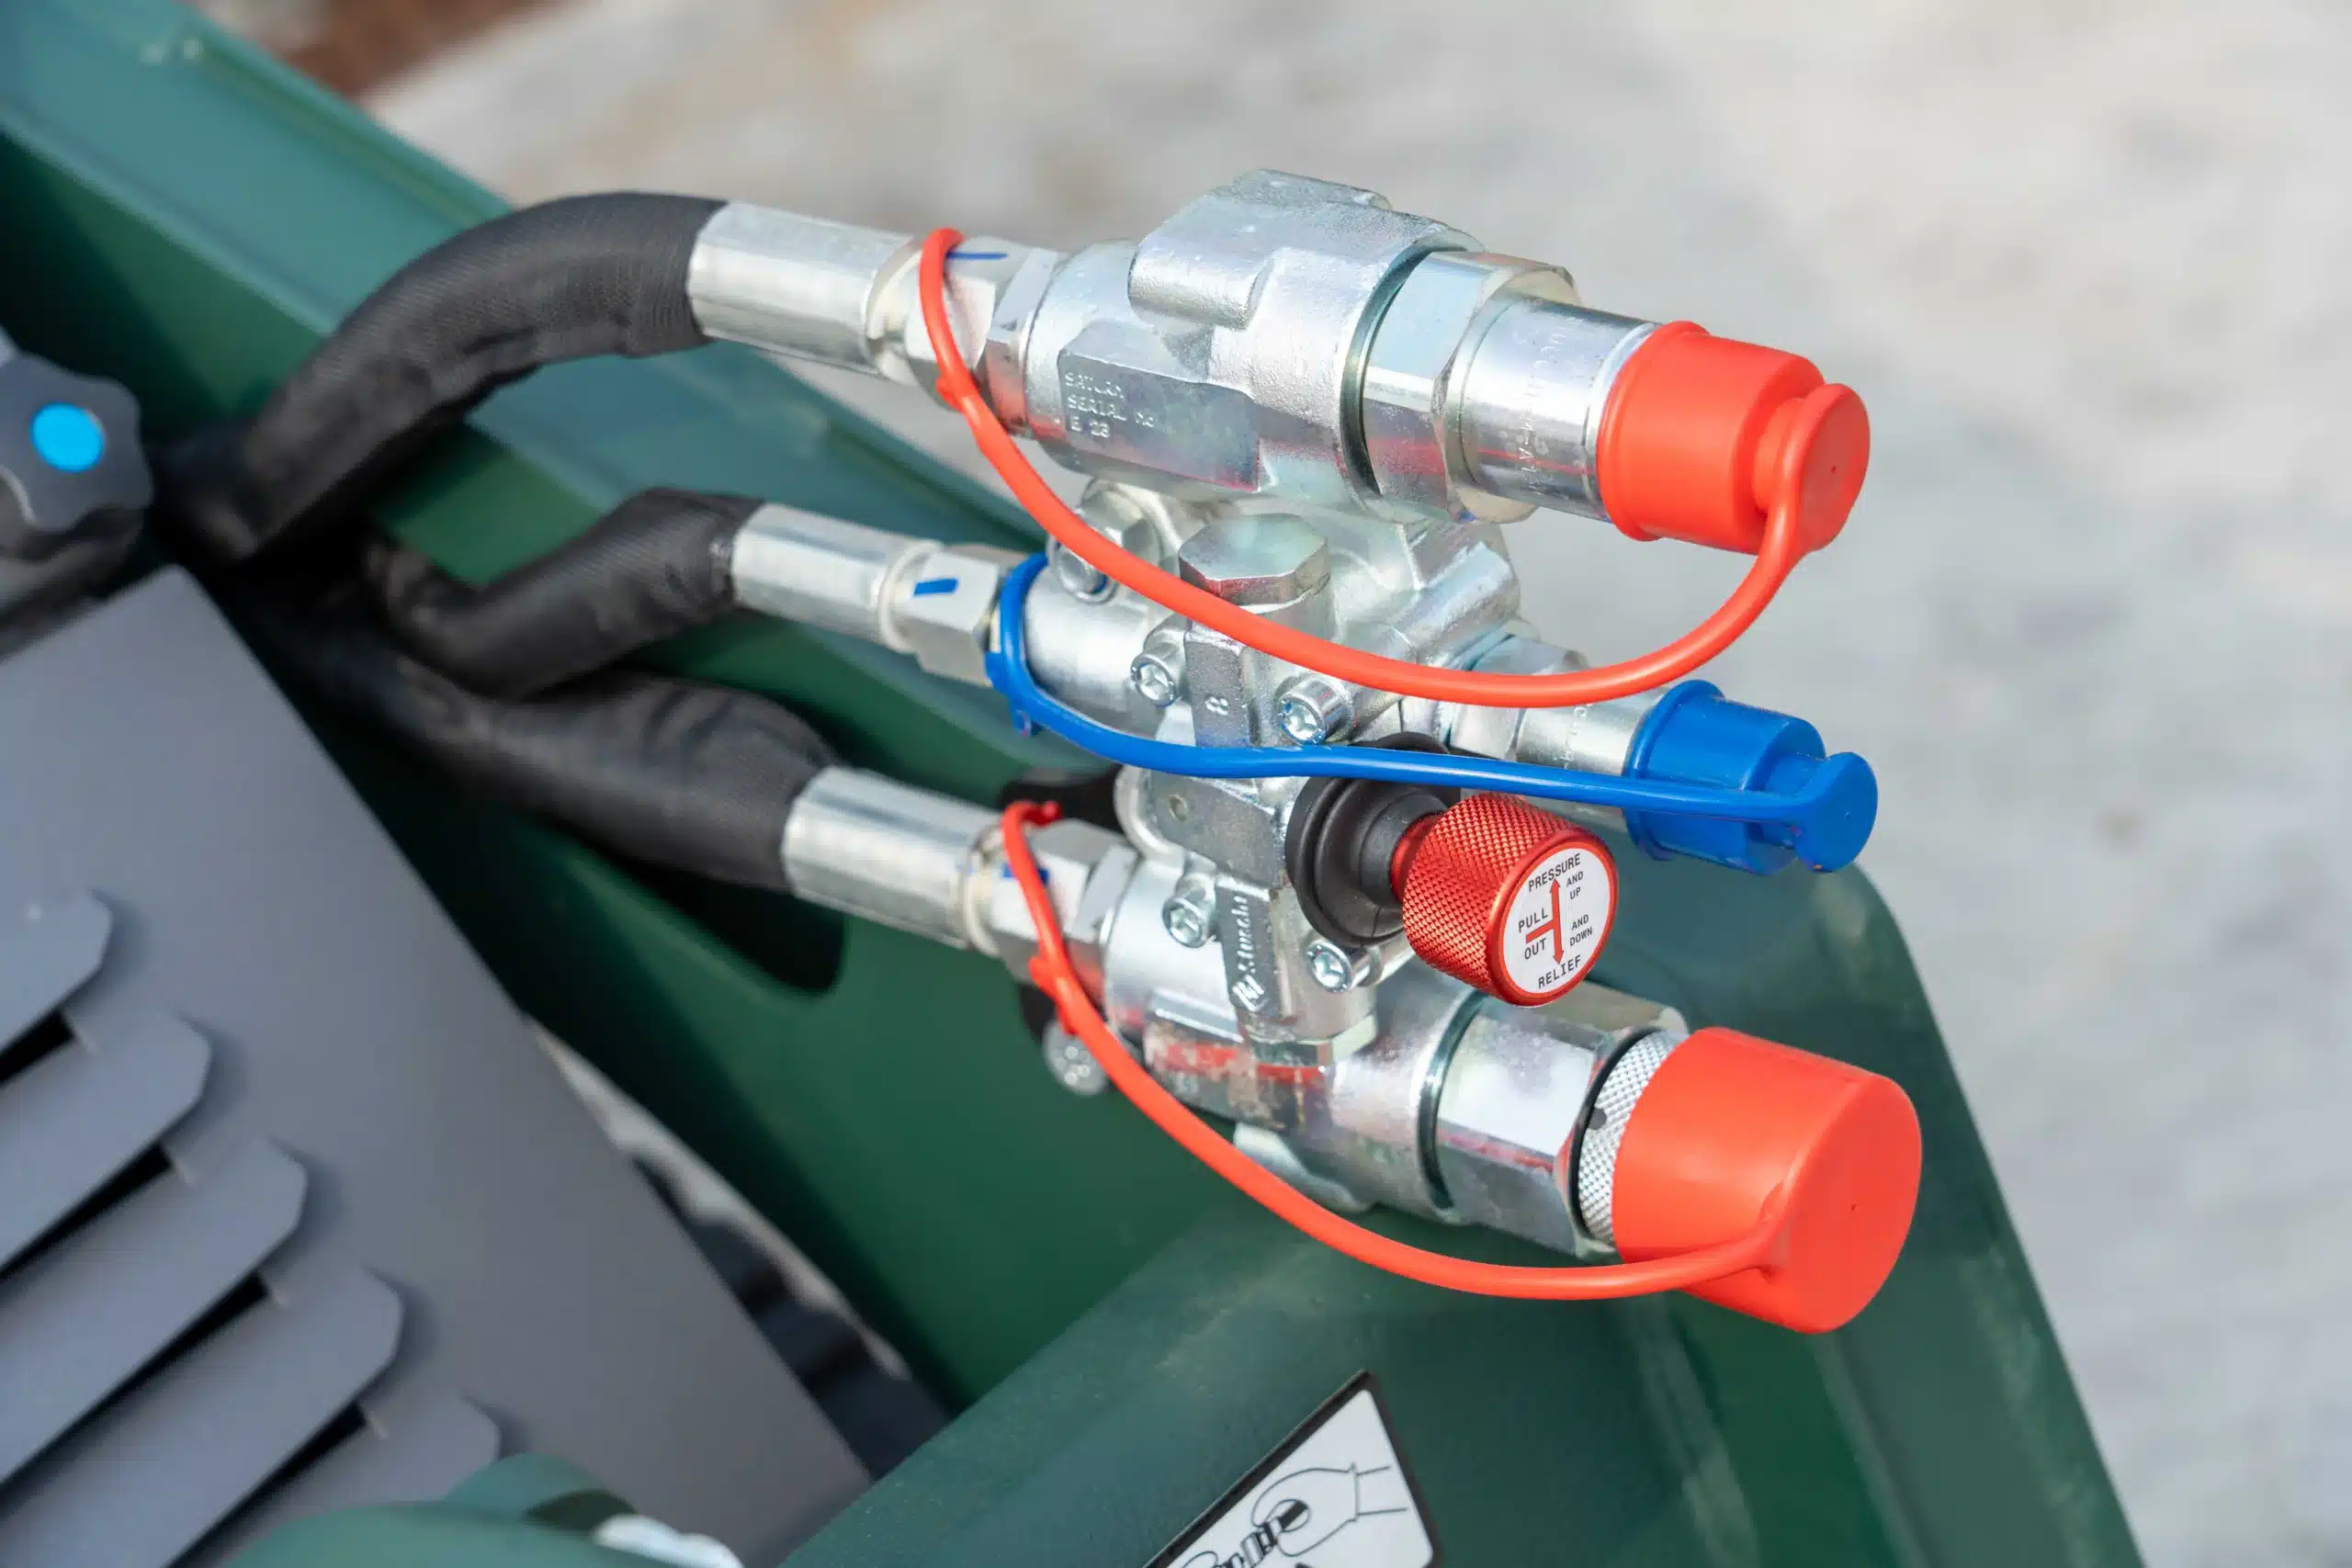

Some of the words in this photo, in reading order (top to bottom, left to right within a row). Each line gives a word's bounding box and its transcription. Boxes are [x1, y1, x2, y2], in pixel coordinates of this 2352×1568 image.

[1067, 394, 1128, 422] SERIAL
[1528, 852, 1581, 892] PRESSURE
[1566, 871, 1584, 888] AND
[1569, 886, 1581, 900] UP
[1518, 908, 1549, 933] PULL
[1571, 914, 1589, 931] AND
[1569, 926, 1593, 947] DOWN
[1523, 938, 1547, 960] OUT
[1538, 954, 1581, 989] RELIEF
